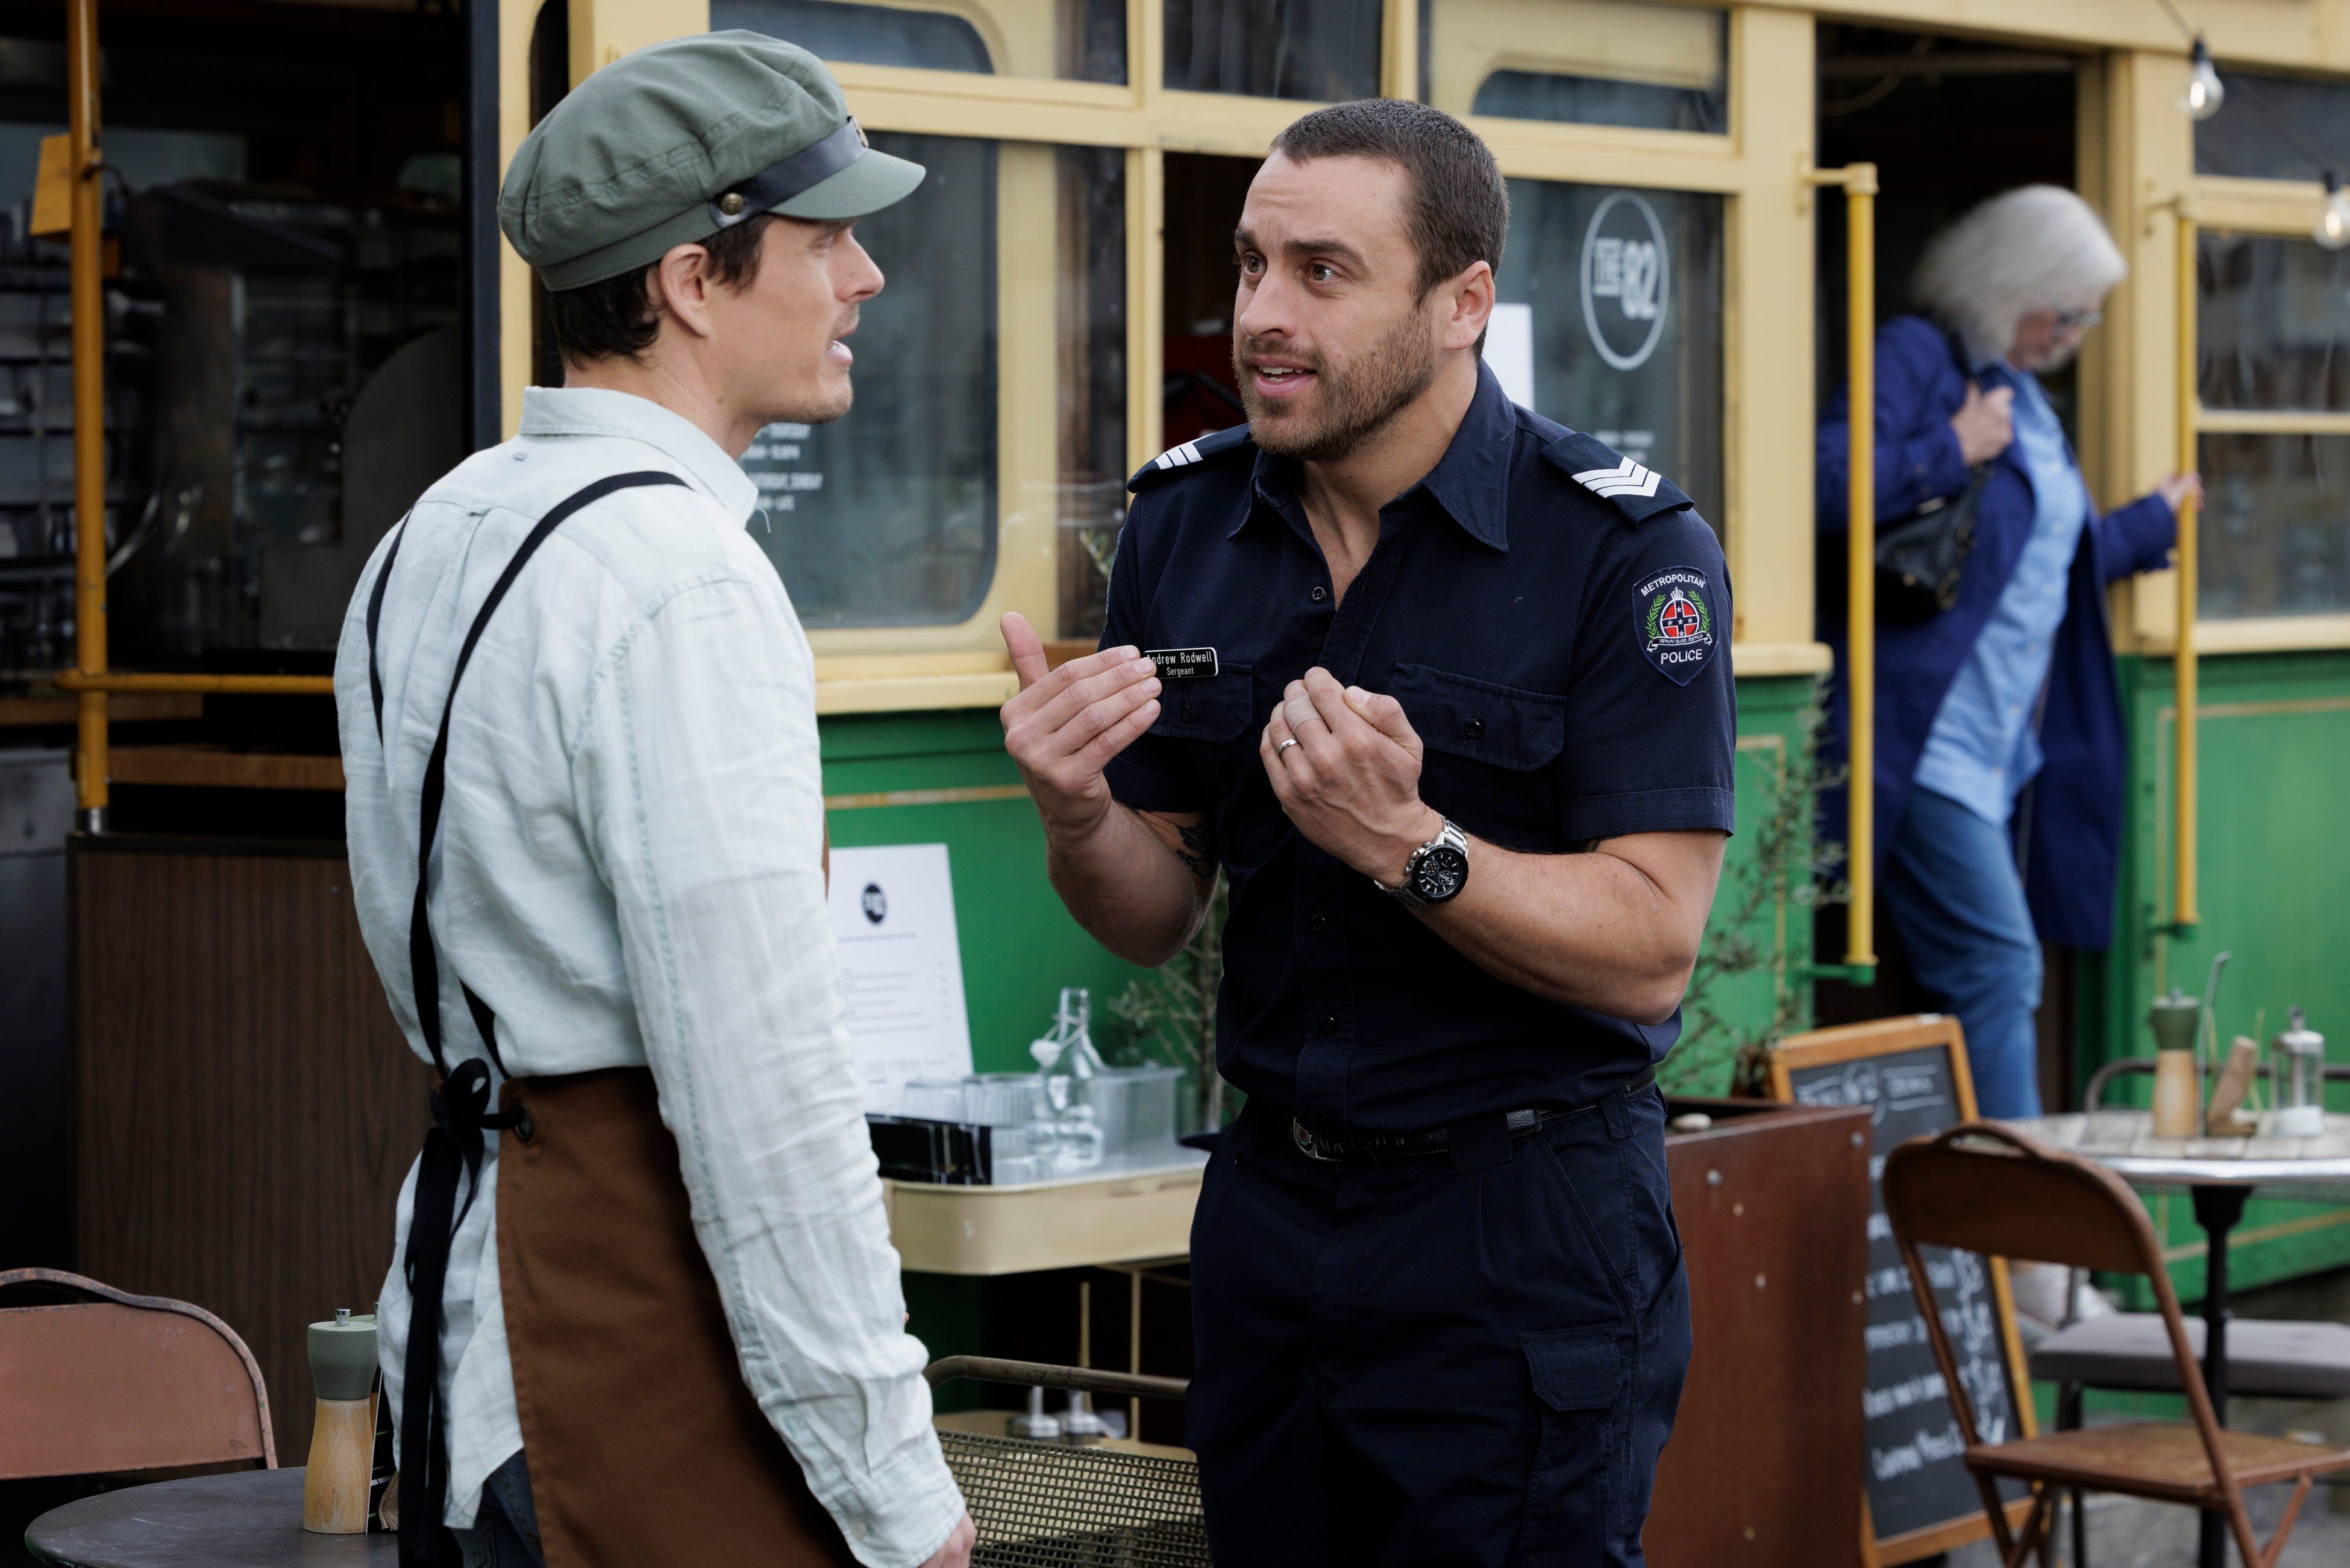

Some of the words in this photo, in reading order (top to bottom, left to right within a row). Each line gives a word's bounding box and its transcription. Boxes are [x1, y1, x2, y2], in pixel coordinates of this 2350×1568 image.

[1622, 240, 1658, 320] 82
[1640, 573, 1704, 596] METROPOLITAN
[1180, 651, 1212, 663] Rodwell
[1660, 648, 1703, 665] POLICE
[1167, 666, 1194, 677] Sergeant
